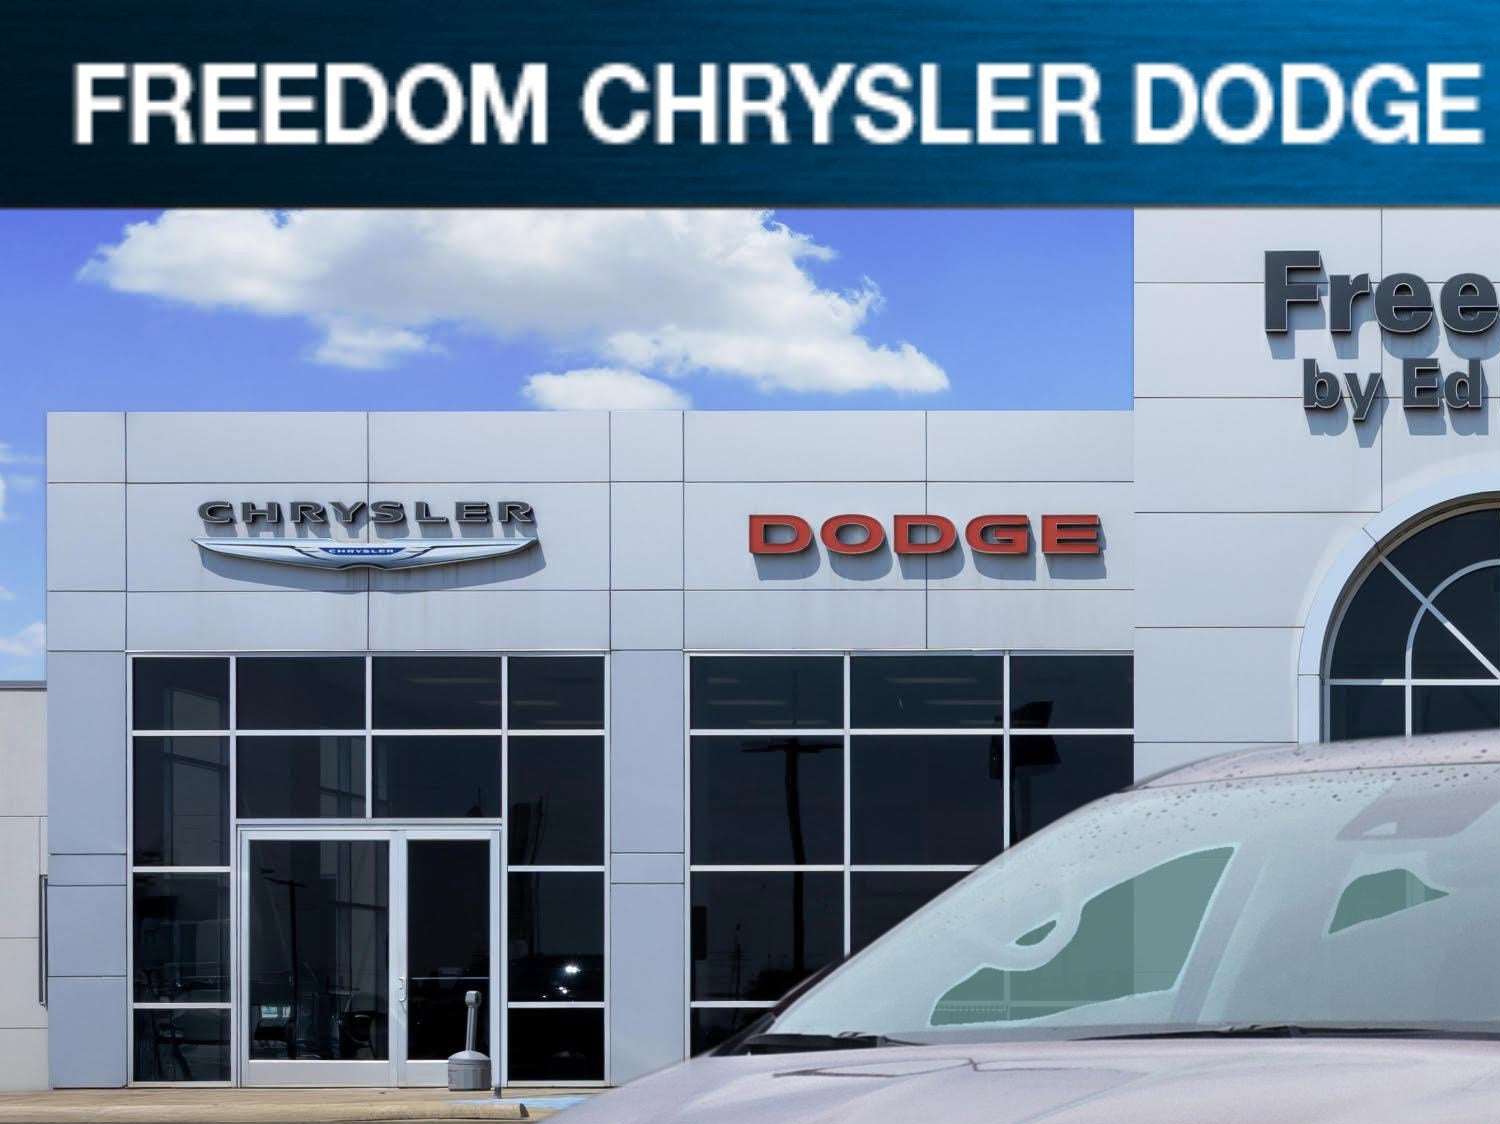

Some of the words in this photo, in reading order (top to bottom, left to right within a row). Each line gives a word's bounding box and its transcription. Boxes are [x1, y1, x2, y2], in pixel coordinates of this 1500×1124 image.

[1302, 358, 1382, 421] by
[1402, 358, 1482, 408] Ed
[197, 500, 537, 524] CHRYSLER
[748, 513, 1101, 554] DODGE
